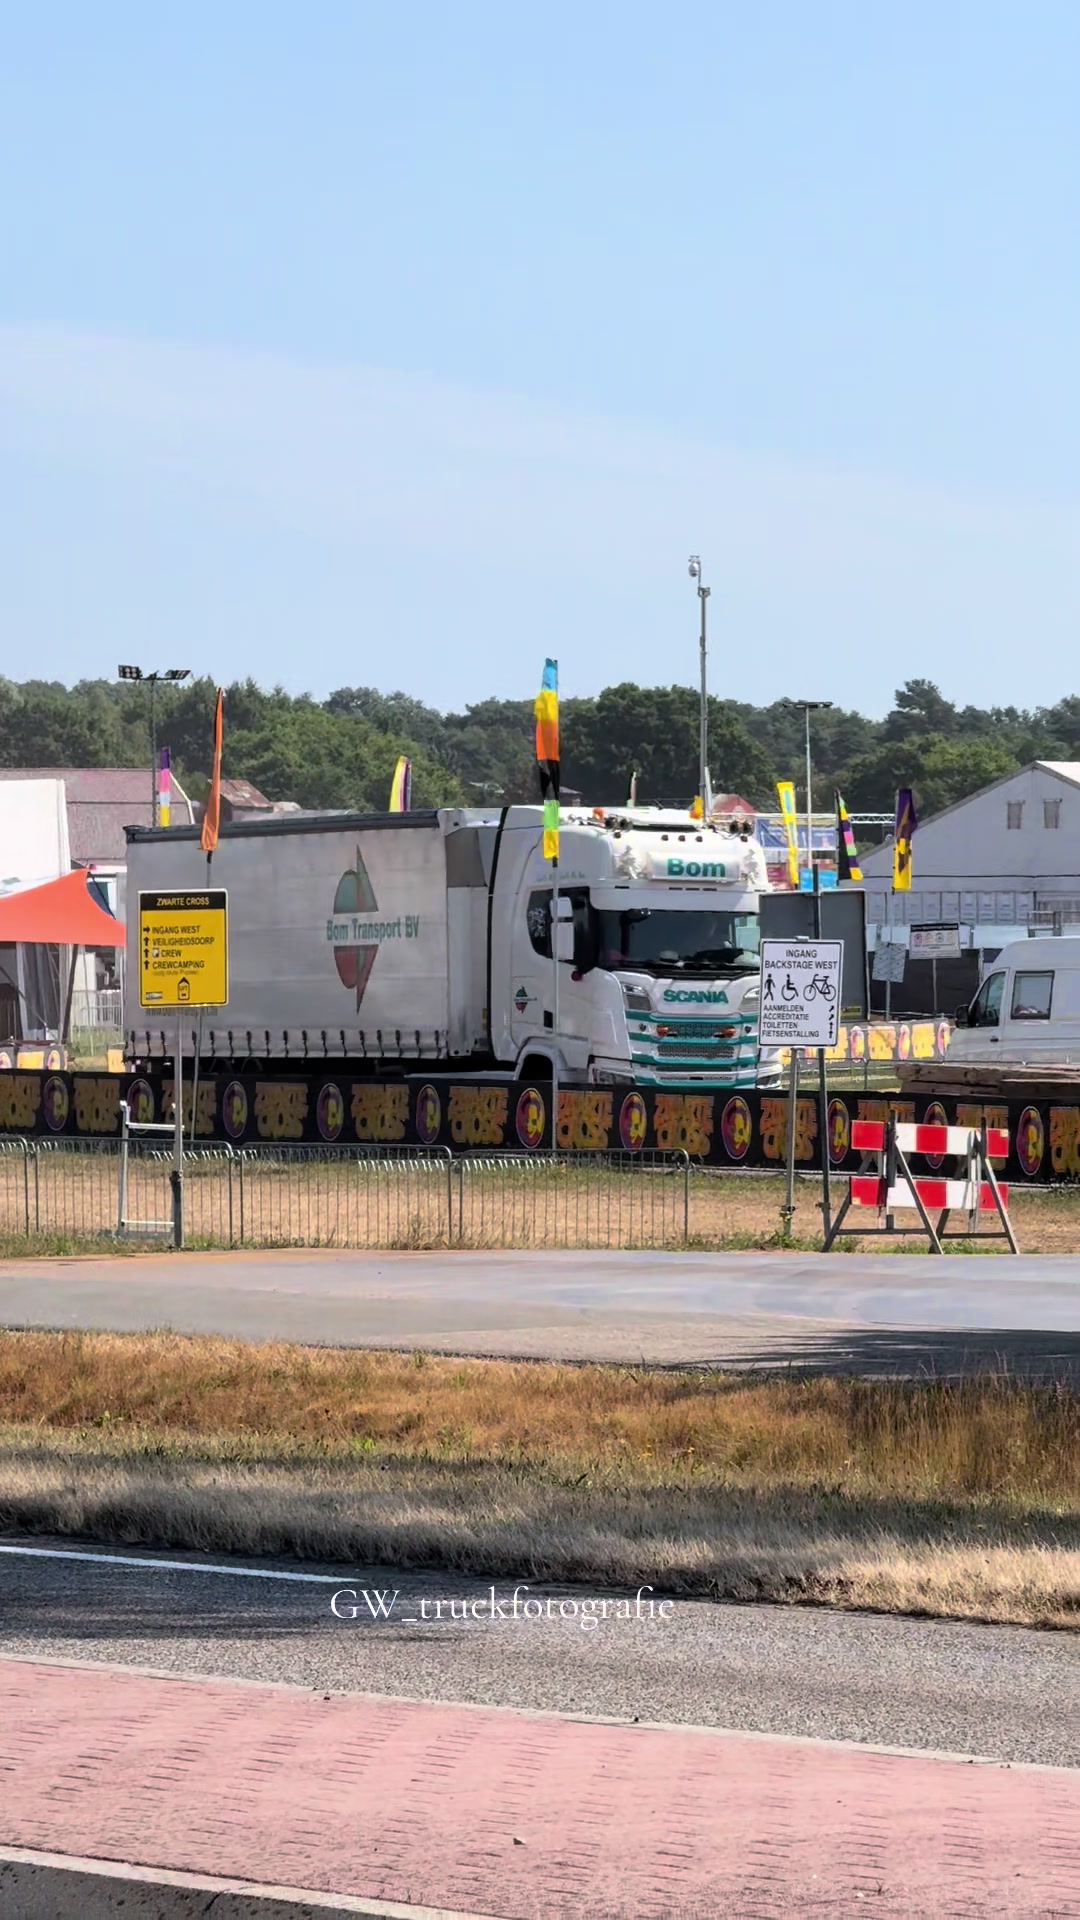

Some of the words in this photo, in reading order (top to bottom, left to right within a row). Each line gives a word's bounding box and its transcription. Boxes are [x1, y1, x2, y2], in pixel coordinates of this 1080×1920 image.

[667, 858, 726, 878] Bom
[156, 898, 185, 907] ZWARTE
[185, 897, 210, 906] CROSS
[151, 926, 180, 935] INGANG
[180, 925, 201, 934] WEST
[326, 919, 349, 941] Bom
[352, 918, 402, 944] Transport
[405, 915, 419, 939] BV
[151, 937, 215, 947] VEILIGHEIDSDORP
[161, 949, 182, 958] CREW
[785, 949, 818, 959] INGANG
[152, 960, 205, 970] CREWCAMPING
[764, 960, 814, 970] BACKSTAGE
[815, 961, 838, 970] WEST
[663, 989, 729, 1004] SCANIA
[763, 1005, 805, 1013] AANMELDEN
[763, 1013, 810, 1021] ACCREDITATIE
[762, 1021, 798, 1029] TOILETTEN
[761, 1030, 820, 1038] FIETSENSTALLING
